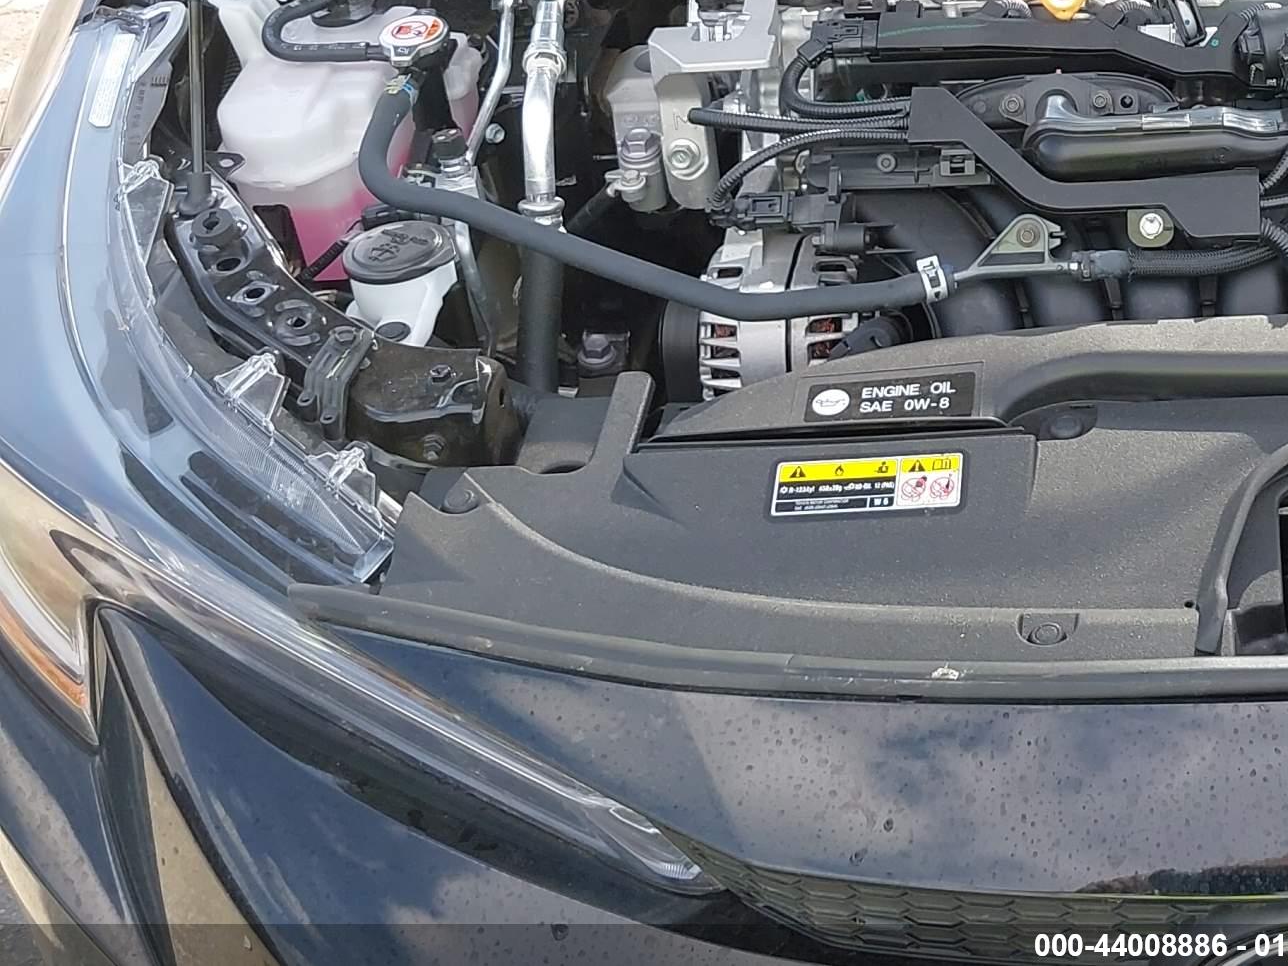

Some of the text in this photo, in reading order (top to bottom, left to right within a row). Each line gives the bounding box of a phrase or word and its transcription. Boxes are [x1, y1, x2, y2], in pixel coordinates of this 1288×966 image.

[861, 381, 956, 399] ENGINE OIL
[859, 396, 950, 413] SAE 0W-8
